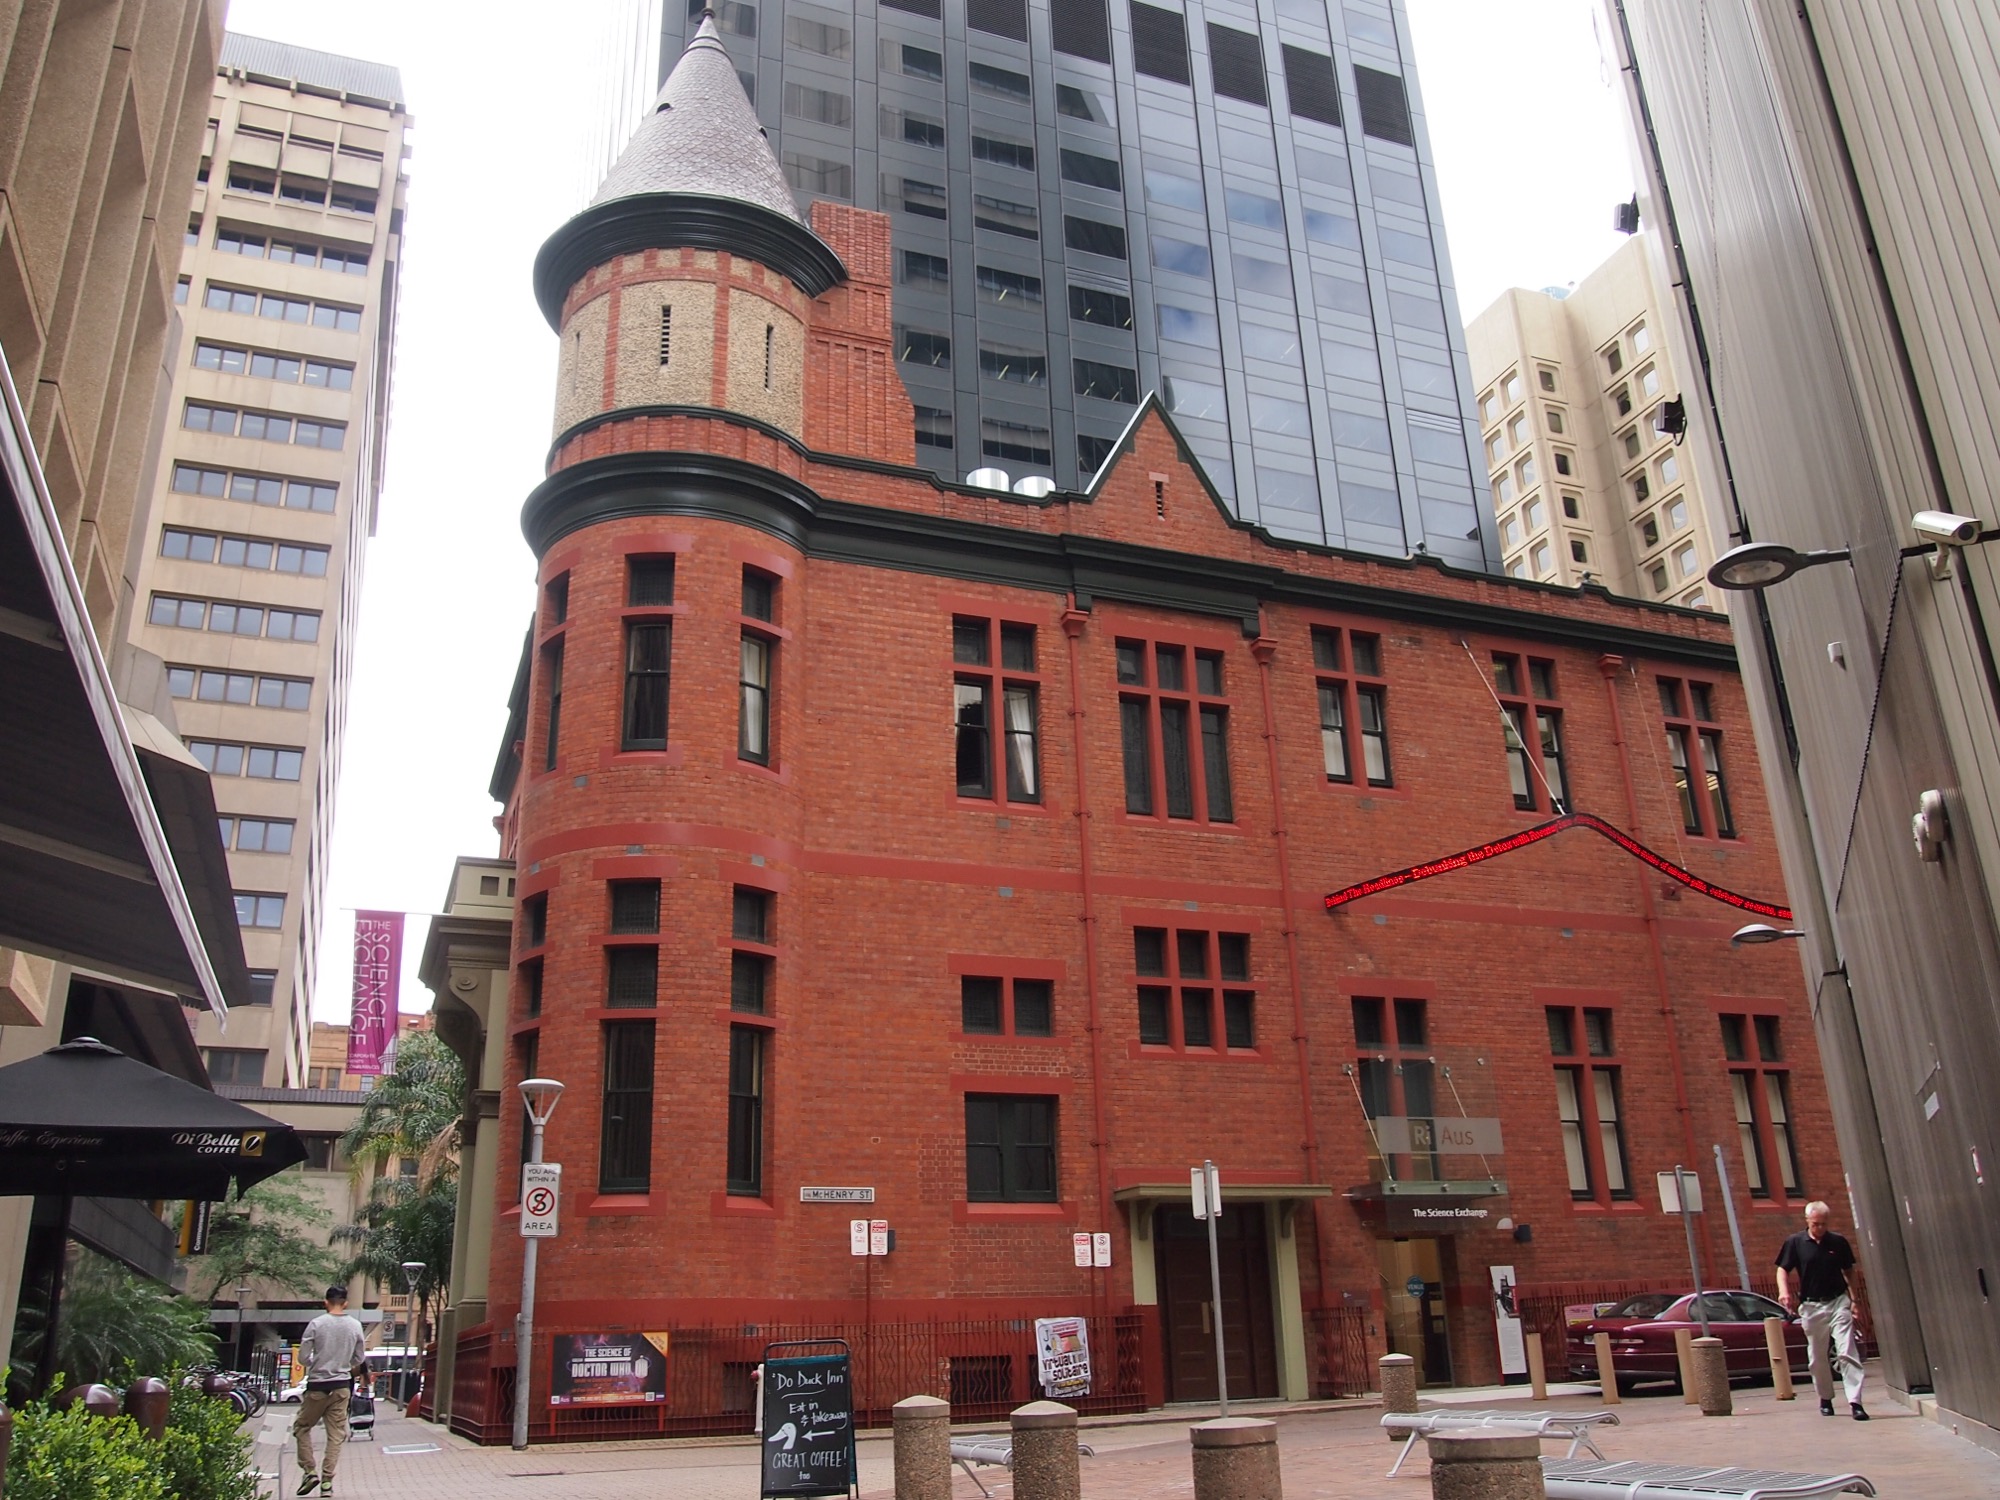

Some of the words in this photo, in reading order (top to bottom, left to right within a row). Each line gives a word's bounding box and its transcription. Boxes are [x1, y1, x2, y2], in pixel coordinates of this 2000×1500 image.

[1411, 856, 1468, 879] Debunking
[1484, 841, 1513, 857] Detox
[373, 920, 391, 931] THE
[349, 919, 372, 1046] EXCHANGE
[367, 932, 391, 1028] SCIENCE
[36, 1130, 103, 1149] Experience
[172, 1132, 197, 1145] Di
[196, 1132, 241, 1147] Bella
[1441, 1125, 1474, 1146] Aus
[197, 1146, 237, 1154] COFFEE
[859, 1190, 870, 1199] ST
[1412, 1208, 1427, 1217] The
[1427, 1208, 1454, 1217] Science
[1455, 1208, 1488, 1218] Exchange
[524, 1222, 553, 1230] AREA
[585, 1348, 597, 1357] THE
[597, 1348, 622, 1357] SCIENCE
[623, 1347, 632, 1357] OF
[571, 1362, 608, 1378] DOCTOR
[609, 1361, 632, 1377] WHO
[797, 1370, 823, 1388] Duck
[788, 1401, 807, 1414] Eat
[808, 1399, 819, 1411] in
[810, 1410, 848, 1430] takeaway
[772, 1451, 807, 1469] GREAT
[809, 1446, 848, 1468] COFFEE!
[798, 1471, 811, 1480] too
